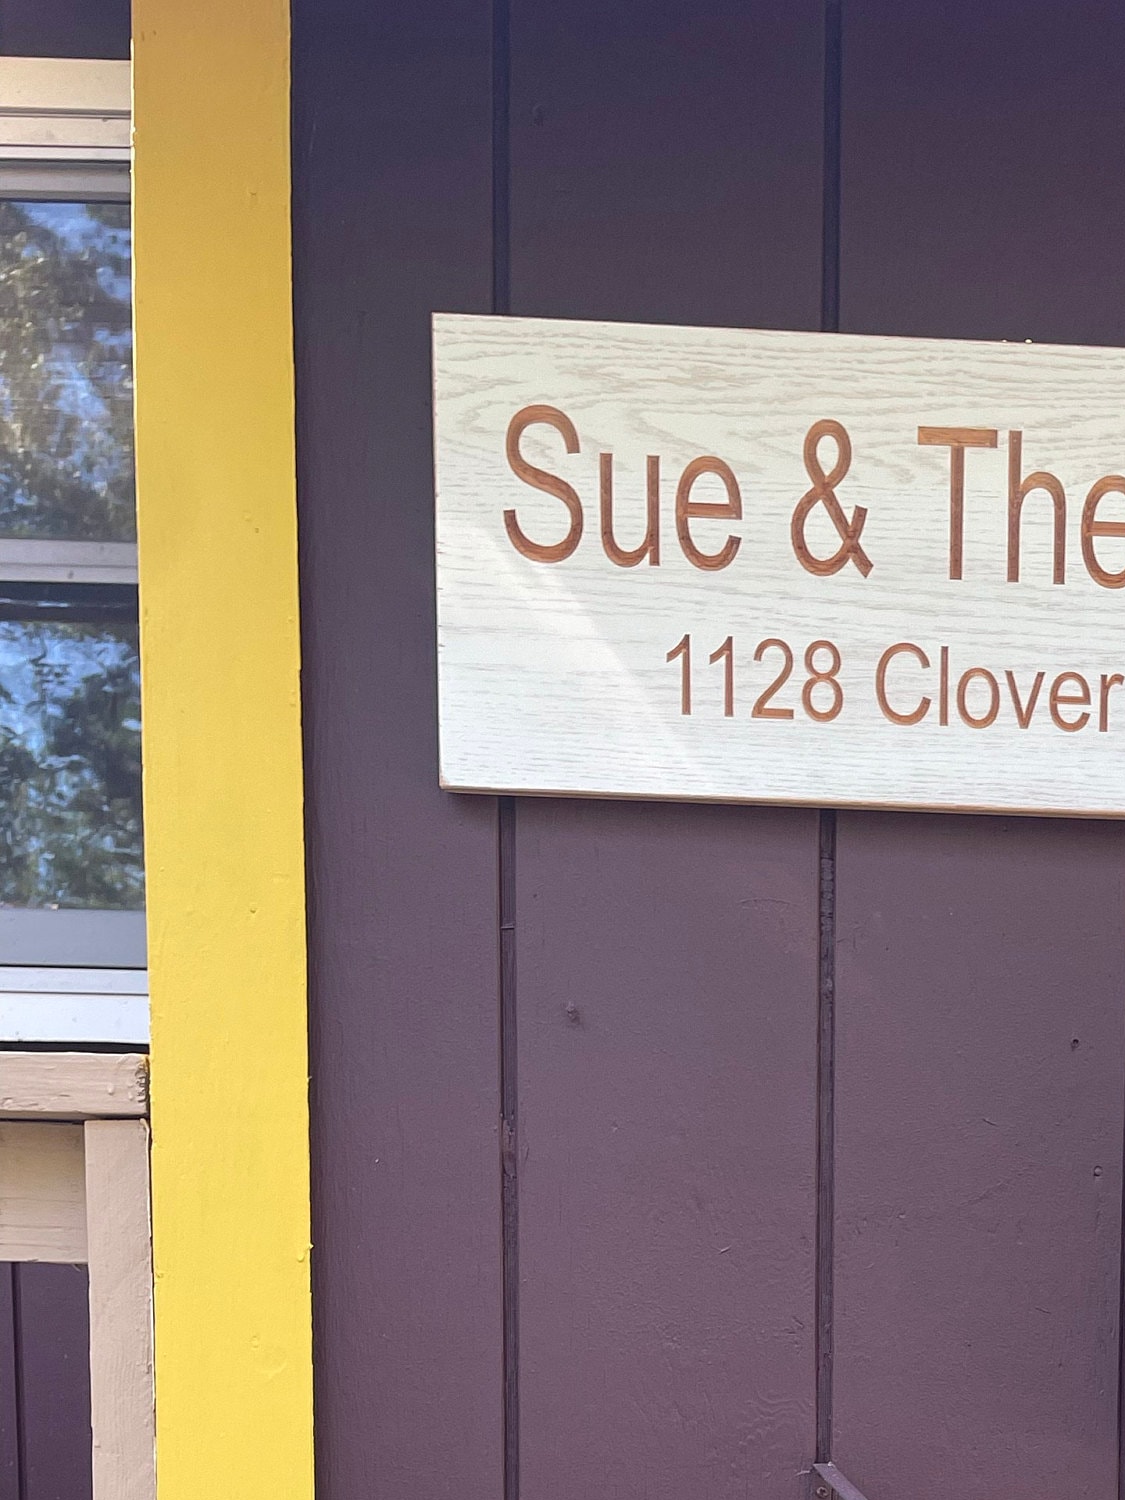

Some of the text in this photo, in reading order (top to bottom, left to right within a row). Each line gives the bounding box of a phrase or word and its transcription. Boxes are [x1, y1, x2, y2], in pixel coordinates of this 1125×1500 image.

[503, 404, 742, 571] Sue
[790, 418, 873, 579] &
[666, 634, 844, 722] 1128
[875, 642, 1124, 733] Clover
